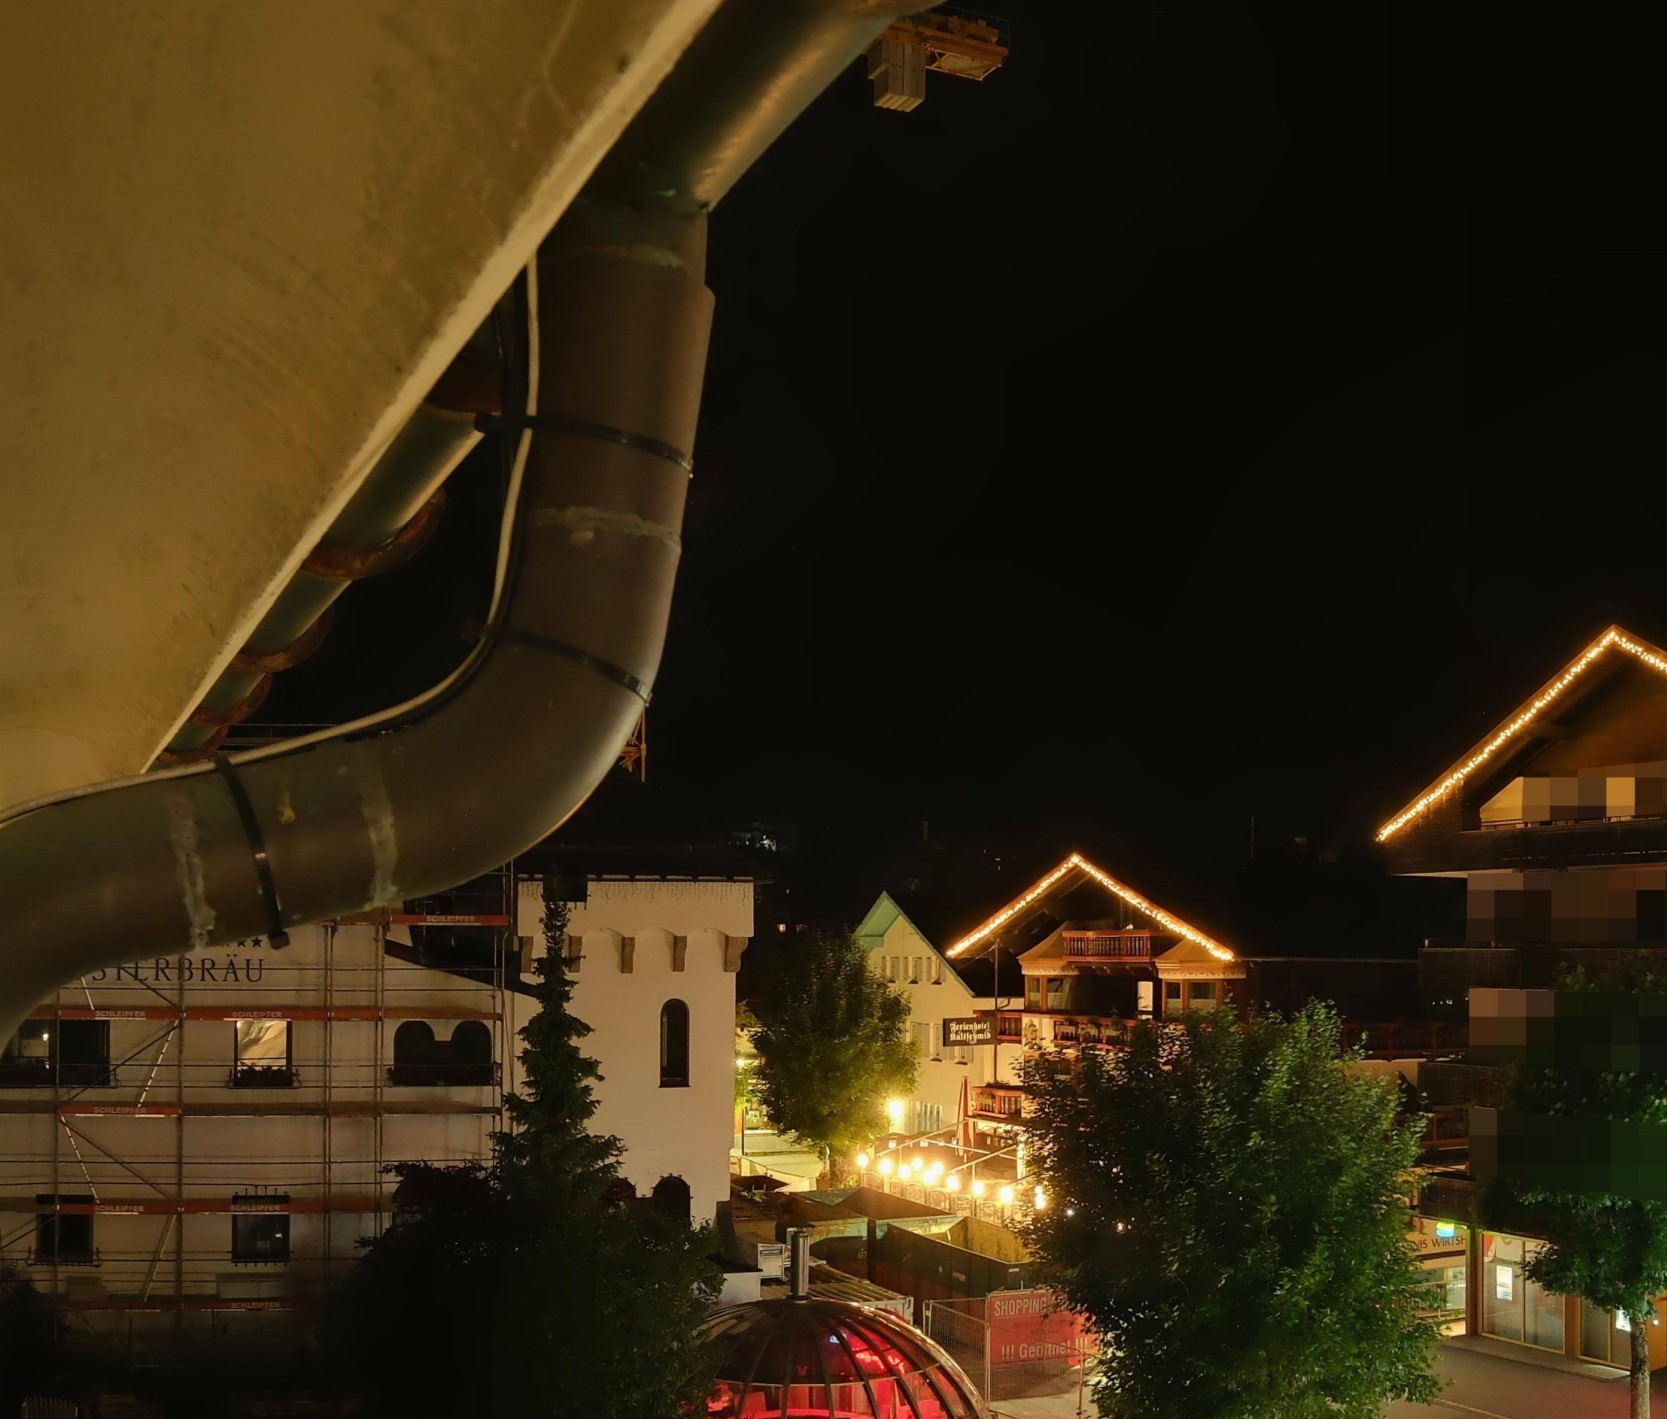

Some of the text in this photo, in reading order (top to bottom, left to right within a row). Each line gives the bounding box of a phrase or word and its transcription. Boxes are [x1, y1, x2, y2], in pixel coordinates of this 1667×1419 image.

[426, 914, 476, 923] SCHLEIPFER
[92, 954, 264, 982] STERBRÄU
[95, 1009, 146, 1018] SCHLEIPFER
[232, 1010, 283, 1019] SCHLEIPFER
[94, 1106, 146, 1115] SCHLEIPFER
[94, 1205, 145, 1213] SCHLEIPFER
[230, 1204, 281, 1213] SCHLEIPFER
[230, 1301, 281, 1310] SCHLEIPFER
[994, 1297, 1047, 1317] SHOPPING
